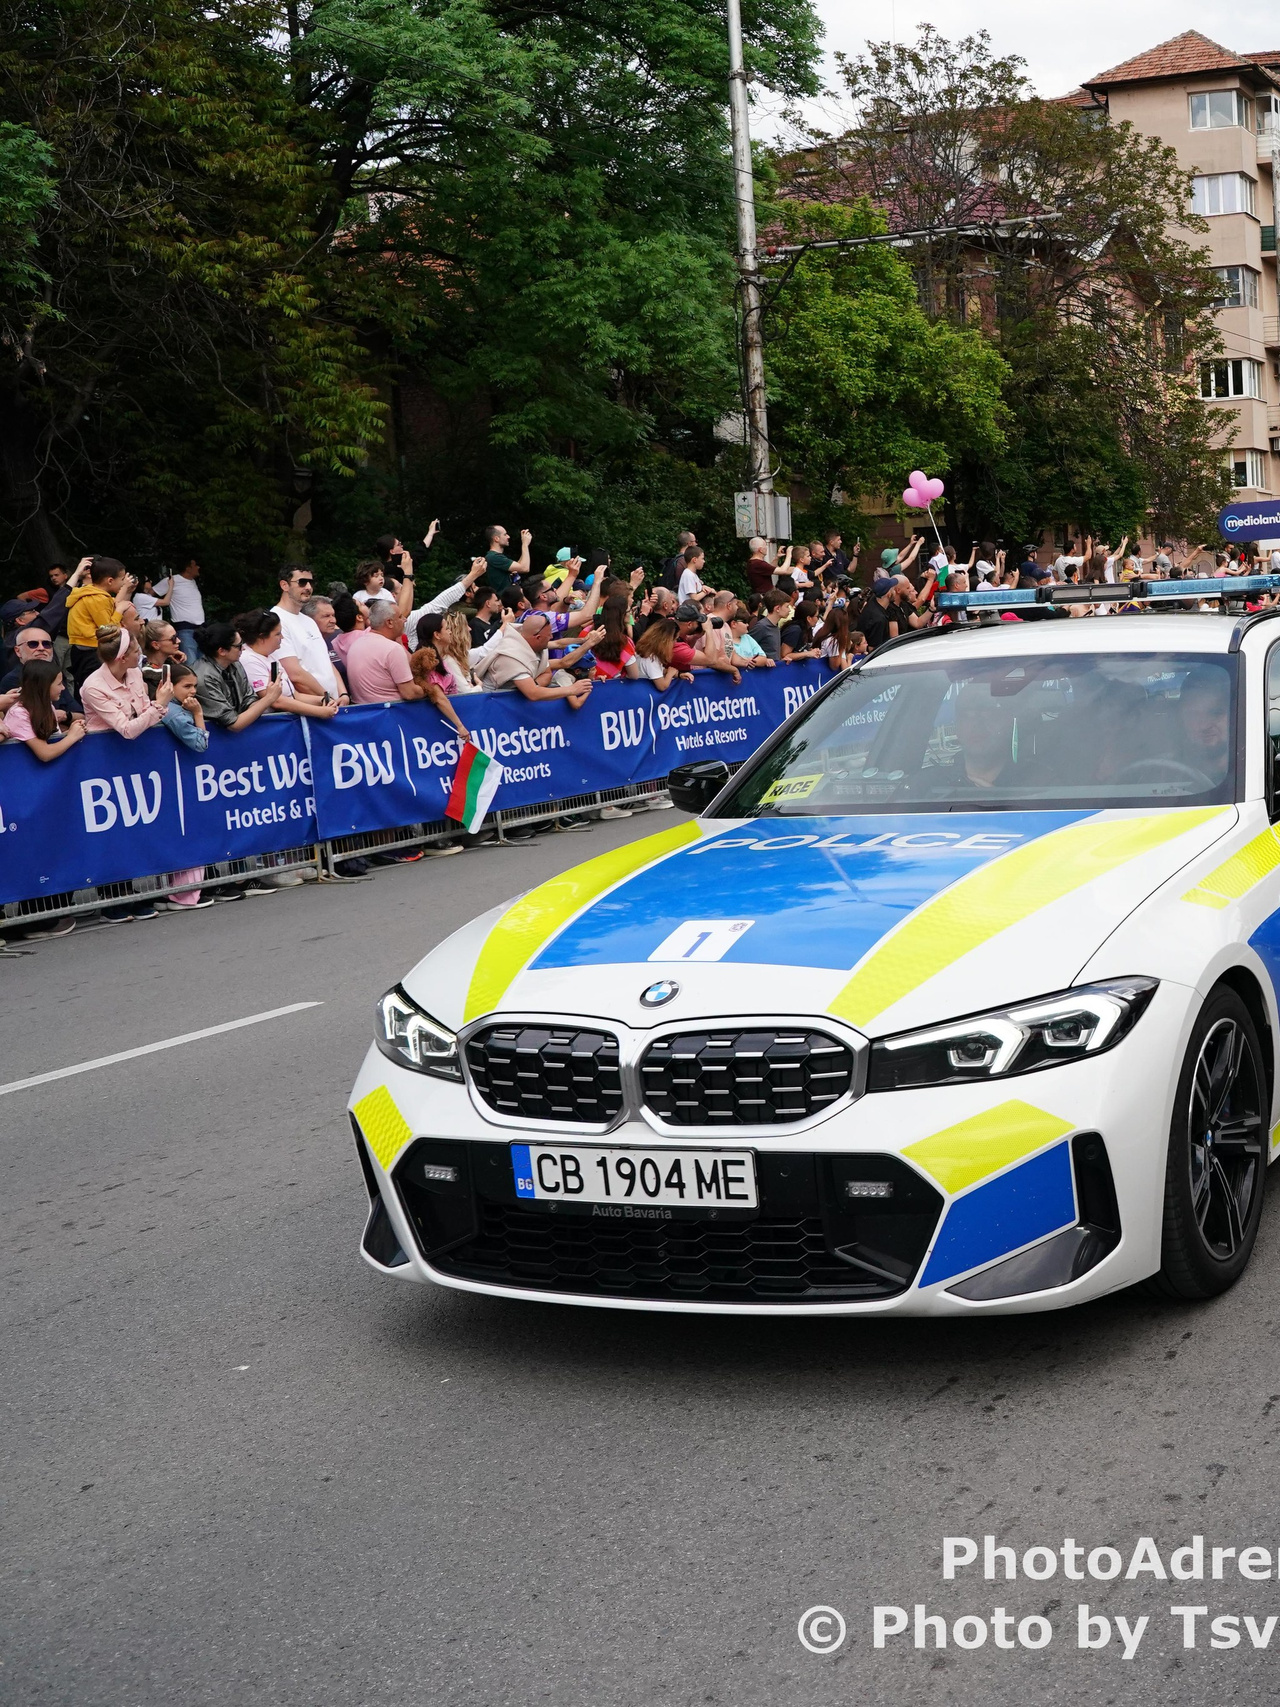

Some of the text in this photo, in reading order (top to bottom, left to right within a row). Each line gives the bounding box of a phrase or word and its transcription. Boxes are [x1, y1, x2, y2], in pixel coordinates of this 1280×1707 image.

[600, 707, 644, 750] BW
[657, 702, 694, 730] Best
[412, 736, 465, 769] Best
[675, 726, 748, 751] Hotels & Resorts
[332, 740, 395, 790] BW
[504, 762, 551, 786] Resorts
[195, 760, 266, 802] Best
[768, 779, 814, 798] RACE
[80, 770, 162, 833] BW
[225, 801, 286, 831] Hotels
[289, 799, 302, 818] &
[685, 832, 1024, 856] POLICE
[682, 932, 713, 958] 1
[518, 1177, 532, 1190] BG
[536, 1153, 749, 1200] CB 1904 ME
[592, 1204, 672, 1220] Auto Bavaria
